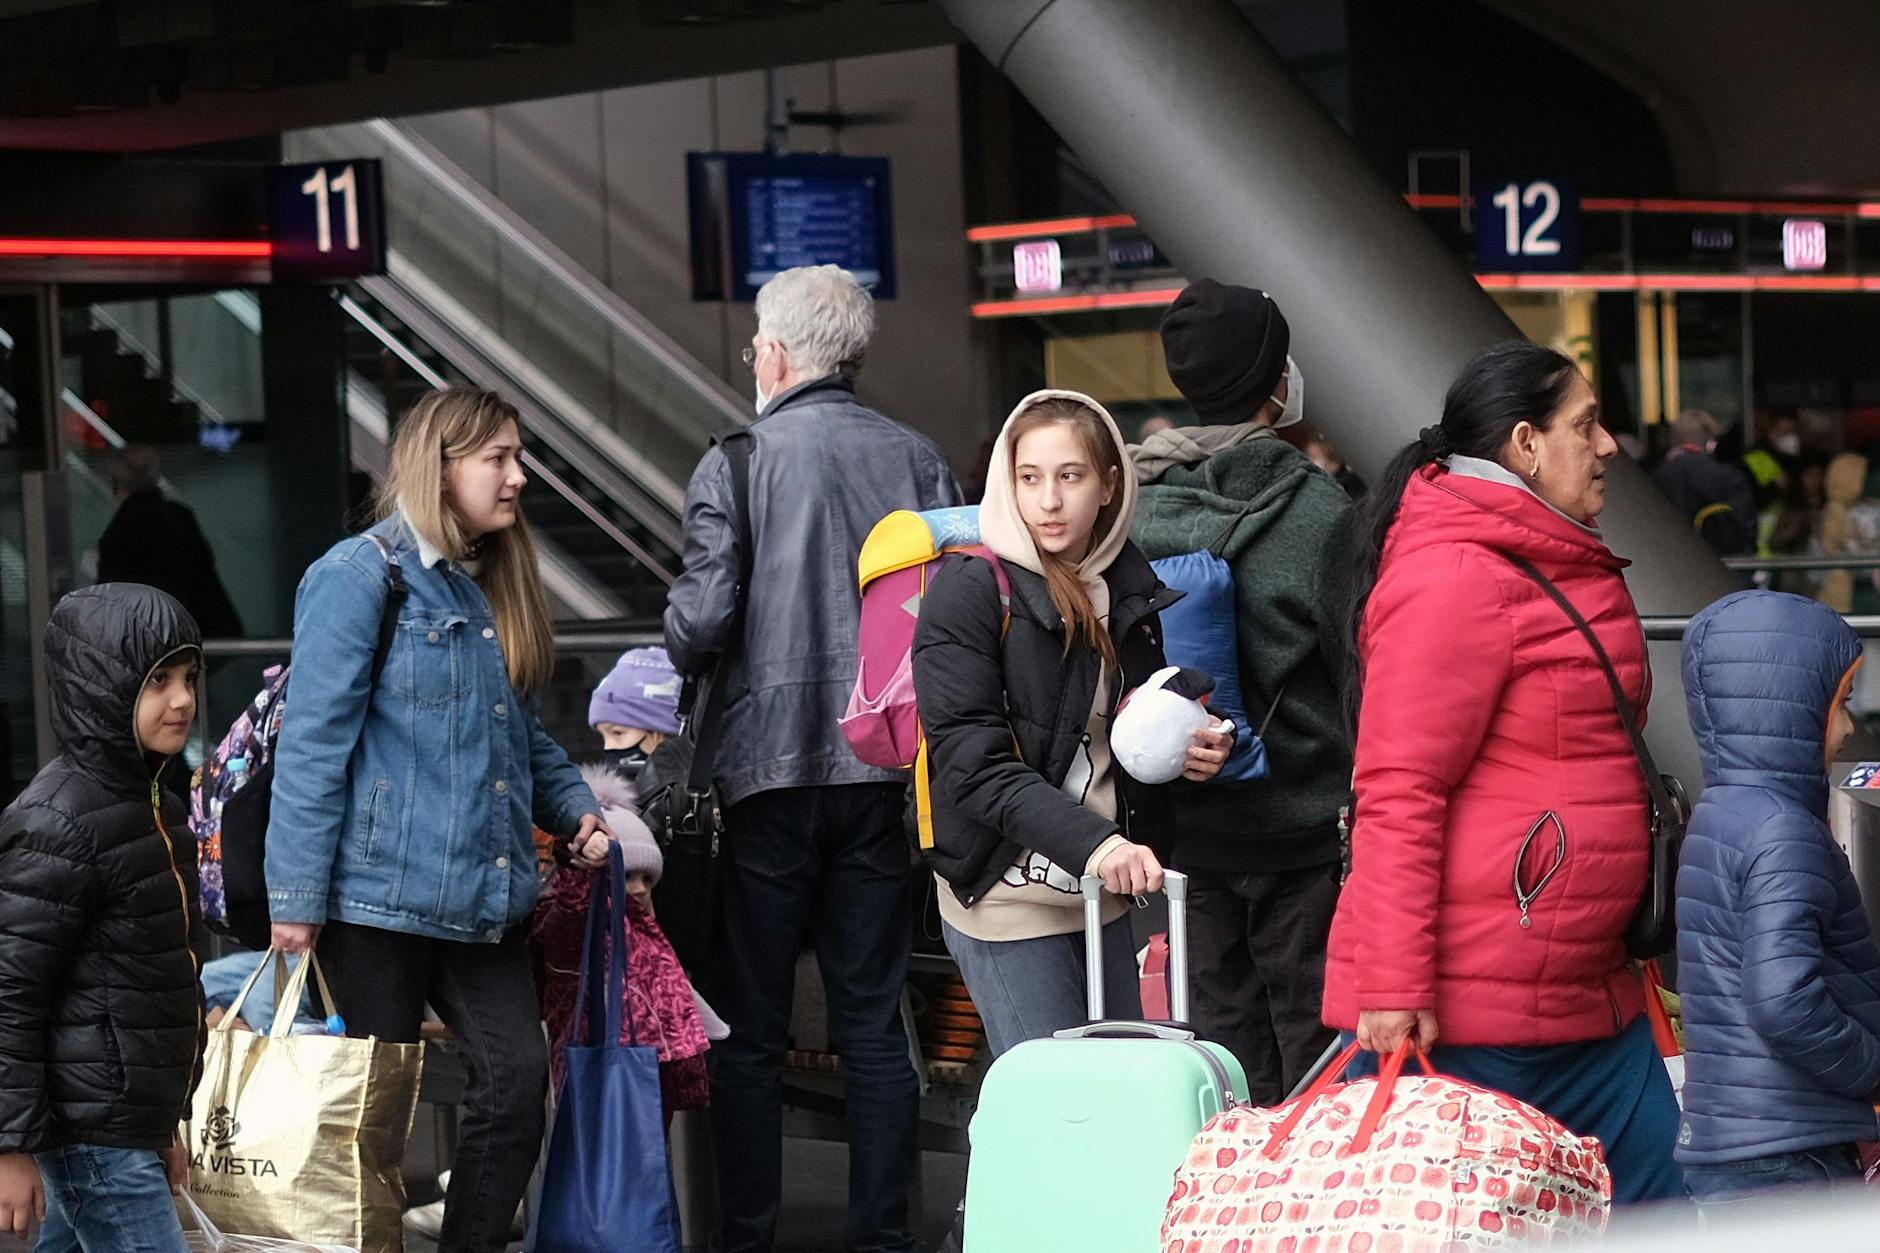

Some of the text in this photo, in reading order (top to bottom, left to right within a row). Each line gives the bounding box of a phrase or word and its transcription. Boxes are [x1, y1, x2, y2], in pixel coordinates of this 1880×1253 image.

[302, 166, 360, 252] 11
[1492, 181, 1561, 255] 12
[187, 1151, 278, 1178] A VISTA
[190, 1182, 240, 1199] Collection
